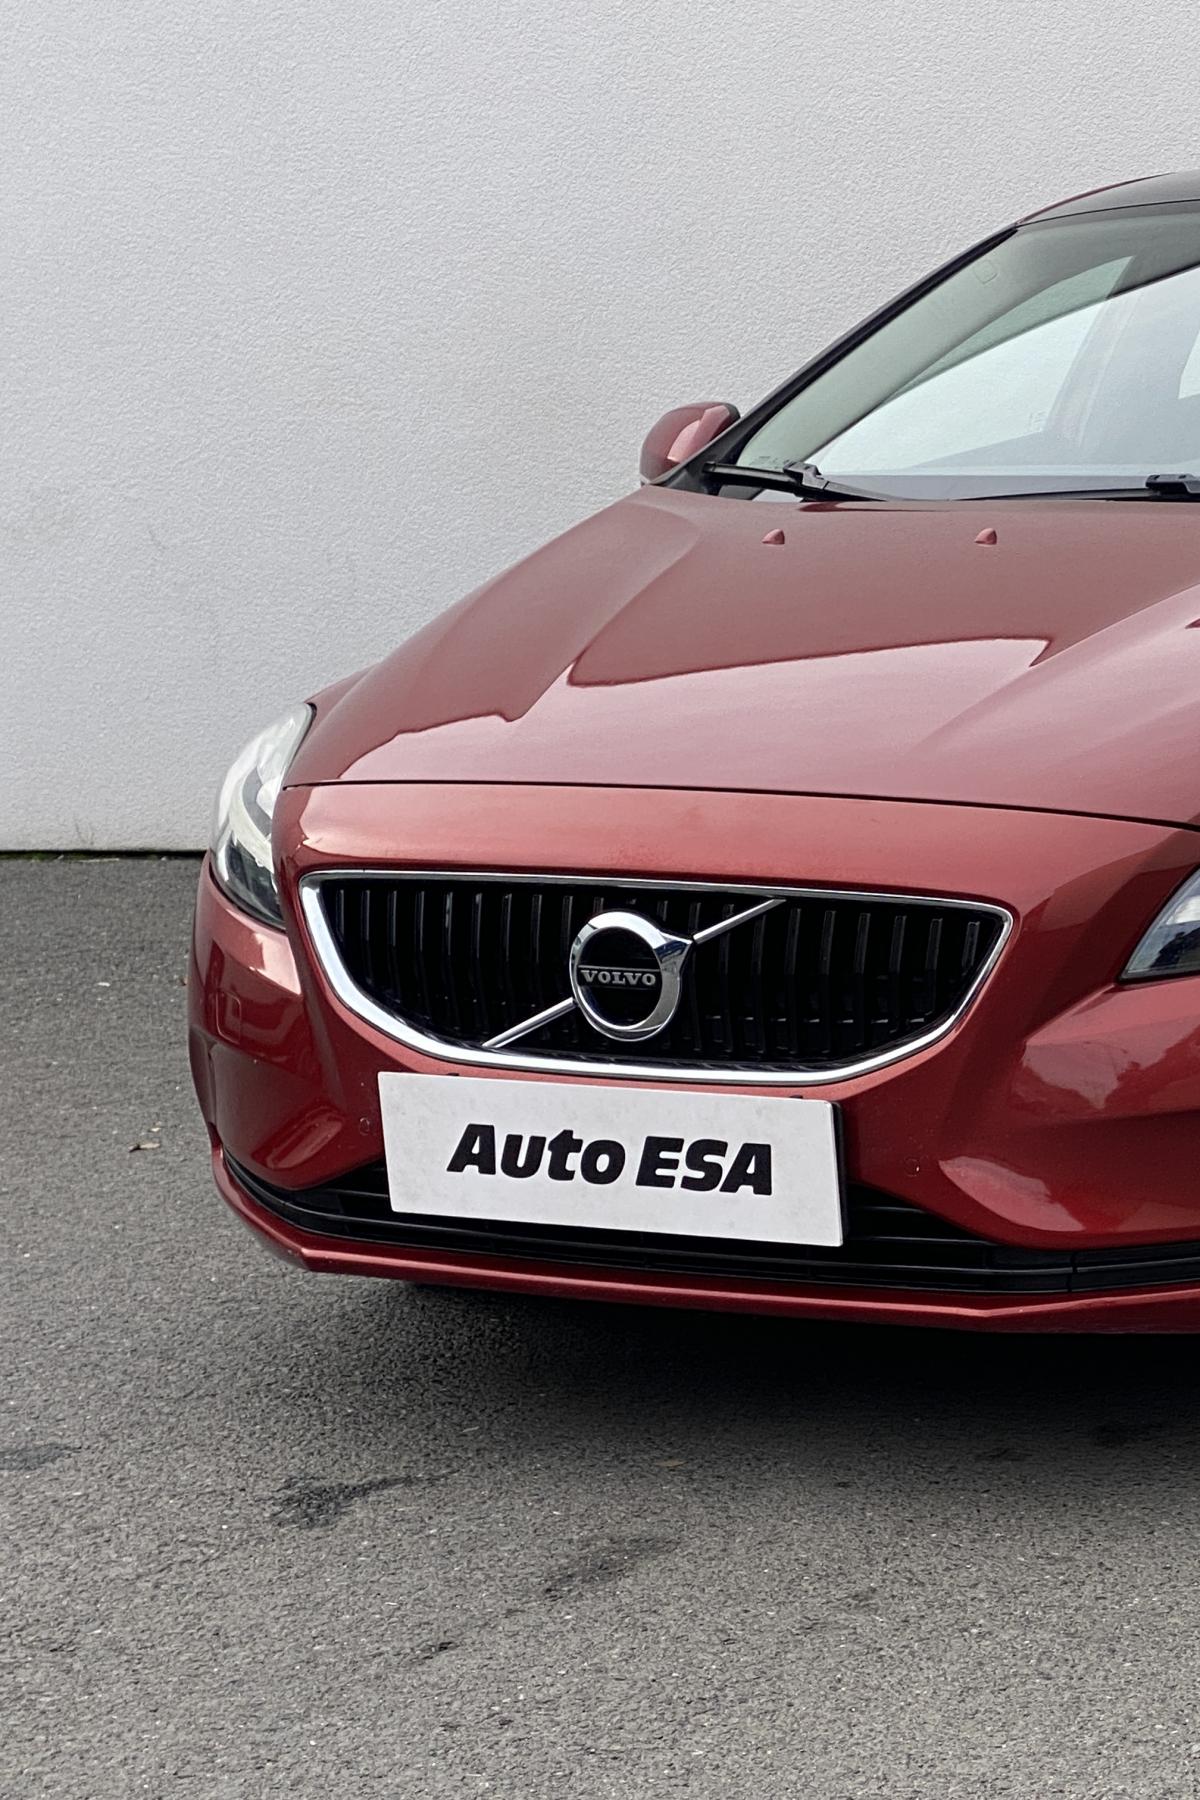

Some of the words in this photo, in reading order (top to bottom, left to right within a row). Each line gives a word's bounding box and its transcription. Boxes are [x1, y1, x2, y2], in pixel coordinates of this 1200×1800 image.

[580, 968, 657, 987] VOLVO
[446, 1123, 626, 1185] Auto
[635, 1135, 773, 1196] ESA
